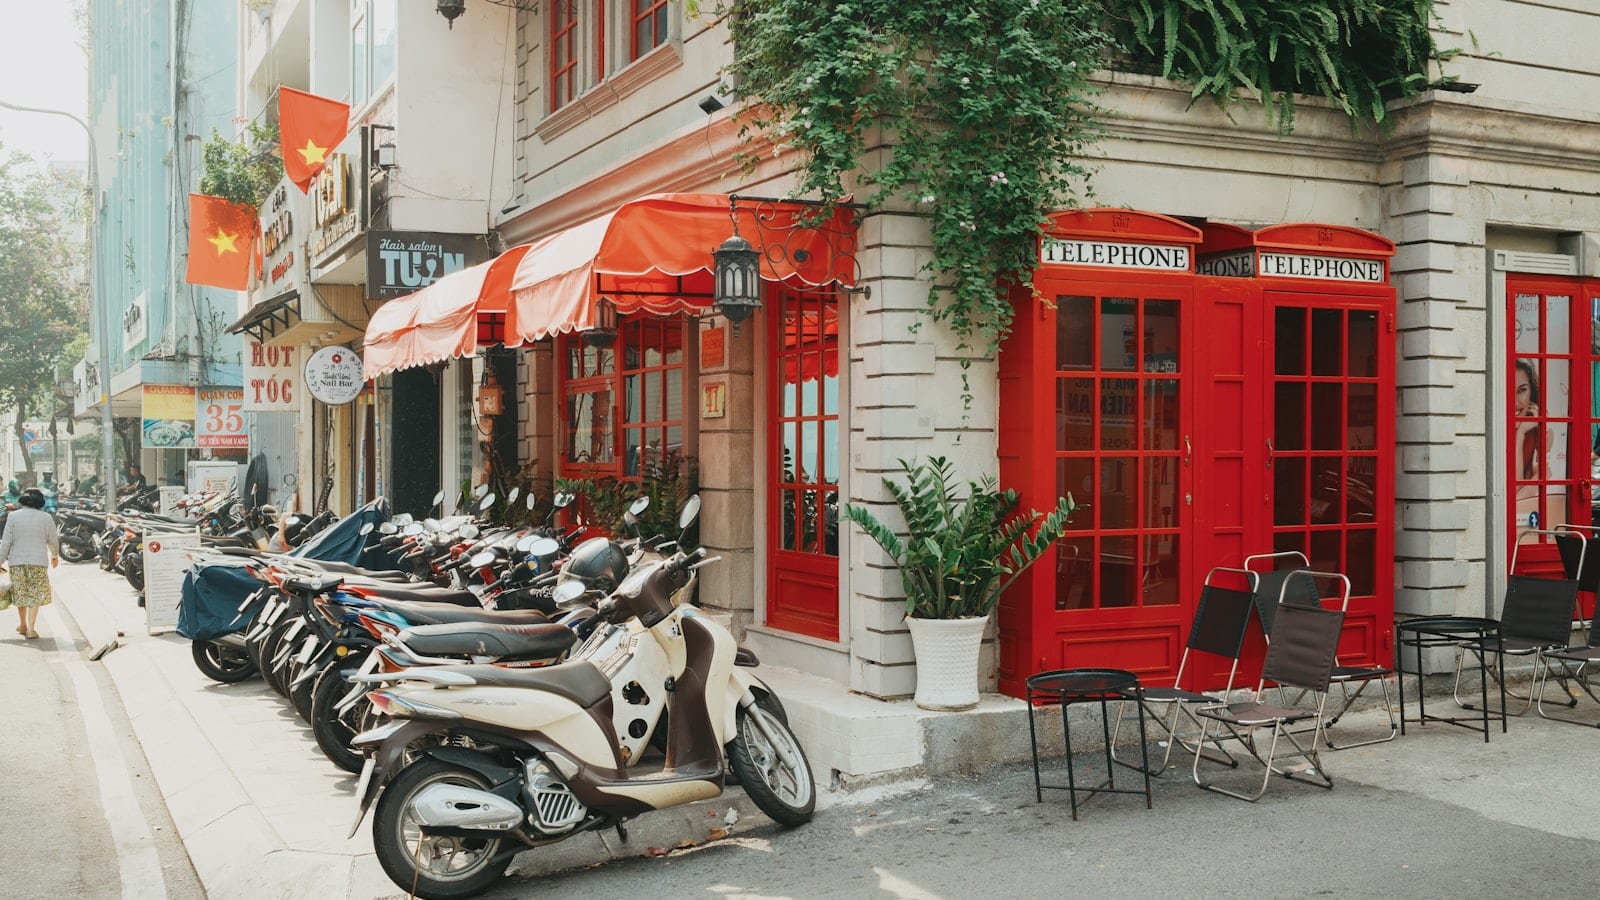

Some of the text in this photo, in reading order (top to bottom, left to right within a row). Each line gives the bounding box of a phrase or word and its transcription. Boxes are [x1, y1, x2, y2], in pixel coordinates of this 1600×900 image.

[380, 239, 436, 251] Hair salon
[1043, 241, 1186, 268] TELEPHONE
[1196, 255, 1250, 277] HONE
[1260, 254, 1379, 281] TELEPHONE
[251, 373, 292, 404] TÓC
[320, 379, 337, 387] Nail
[206, 404, 244, 432] 35
